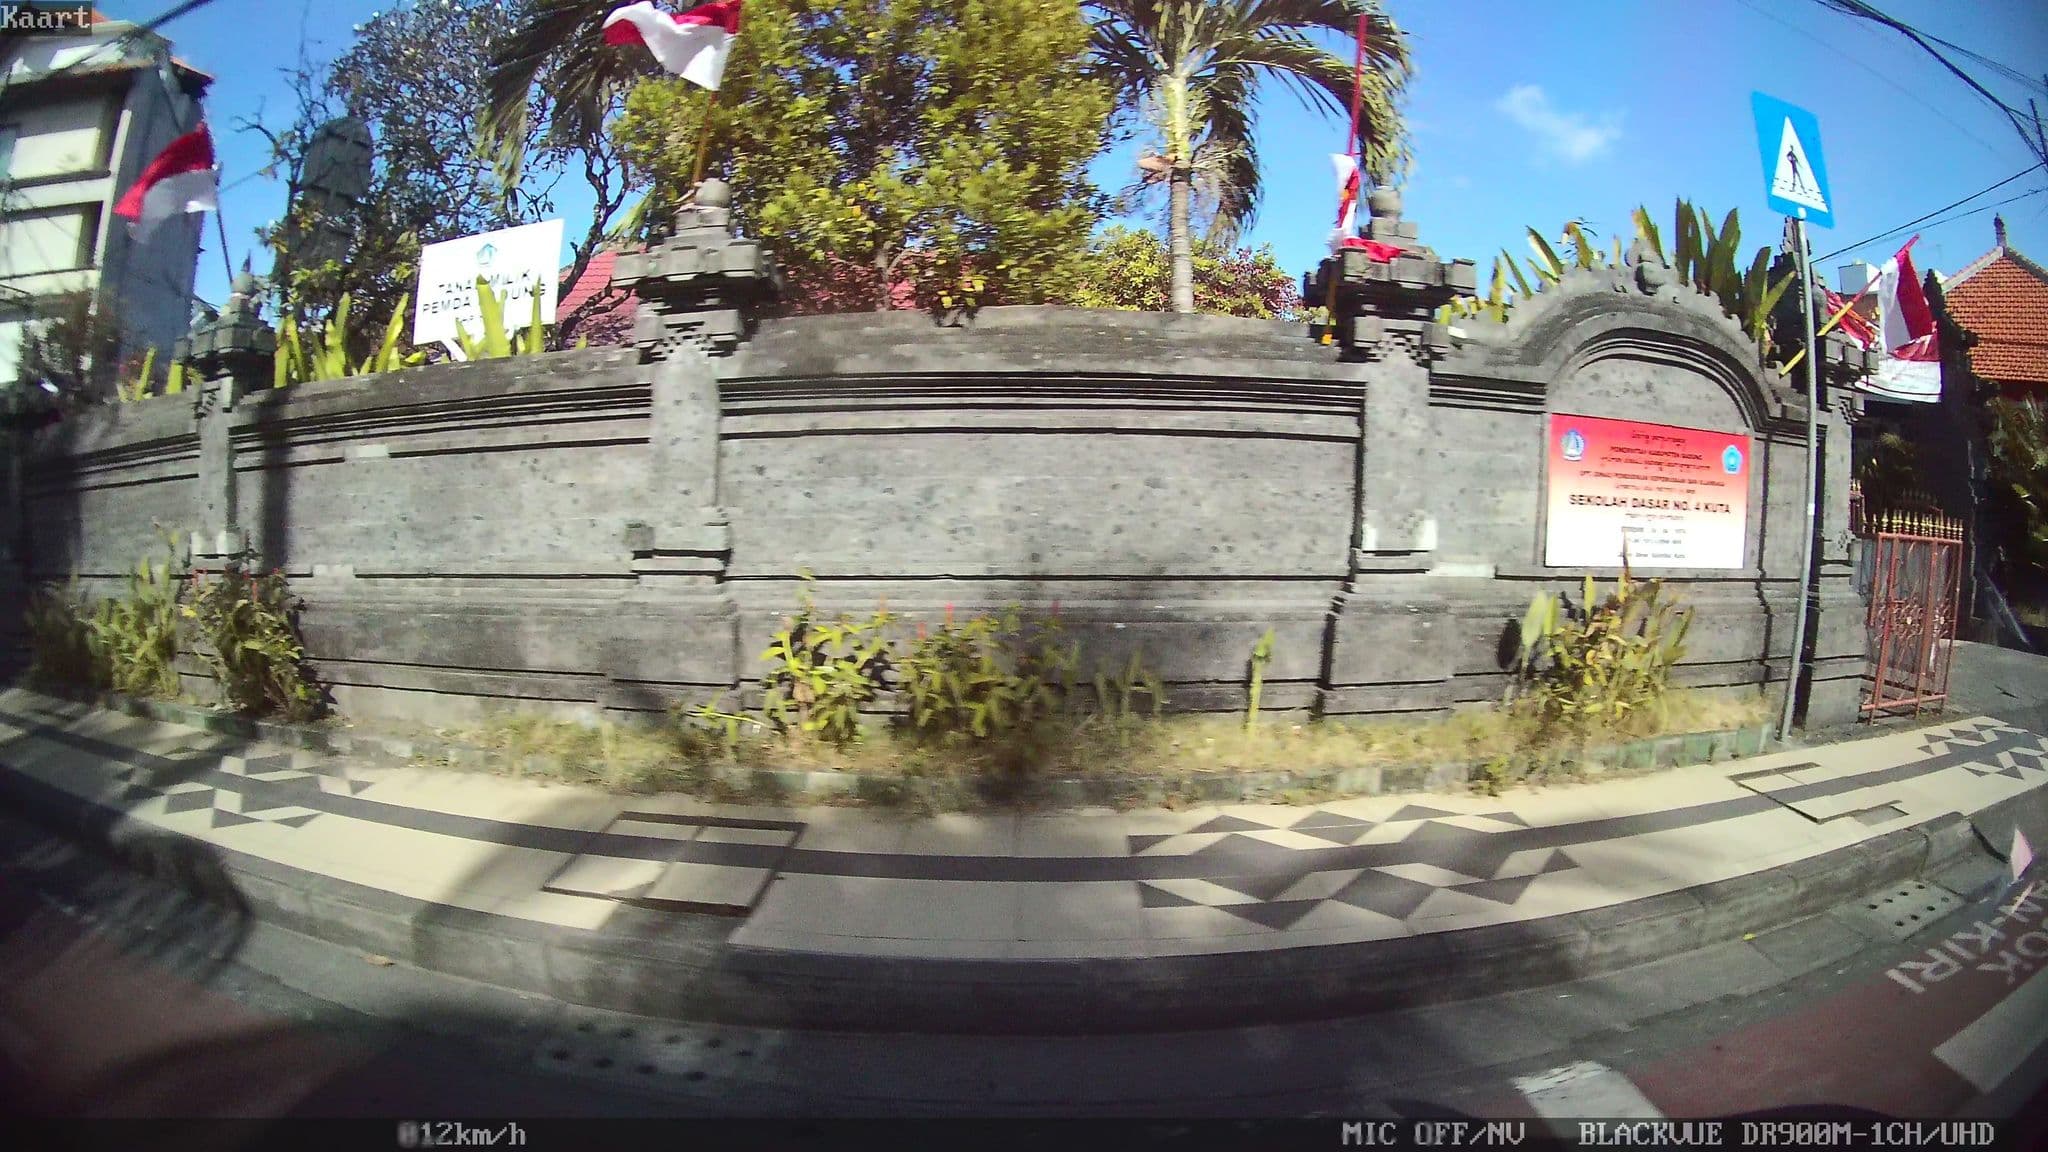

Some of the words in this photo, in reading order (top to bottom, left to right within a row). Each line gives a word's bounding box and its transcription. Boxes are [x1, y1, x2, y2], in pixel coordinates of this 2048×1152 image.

[438, 279, 472, 294] TANA
[422, 296, 471, 314] PEMDA
[1568, 494, 1628, 509] SEKOLAH
[1632, 497, 1669, 510] DASAR
[1673, 500, 1691, 512] NO.
[1704, 503, 1731, 514] KUTA
